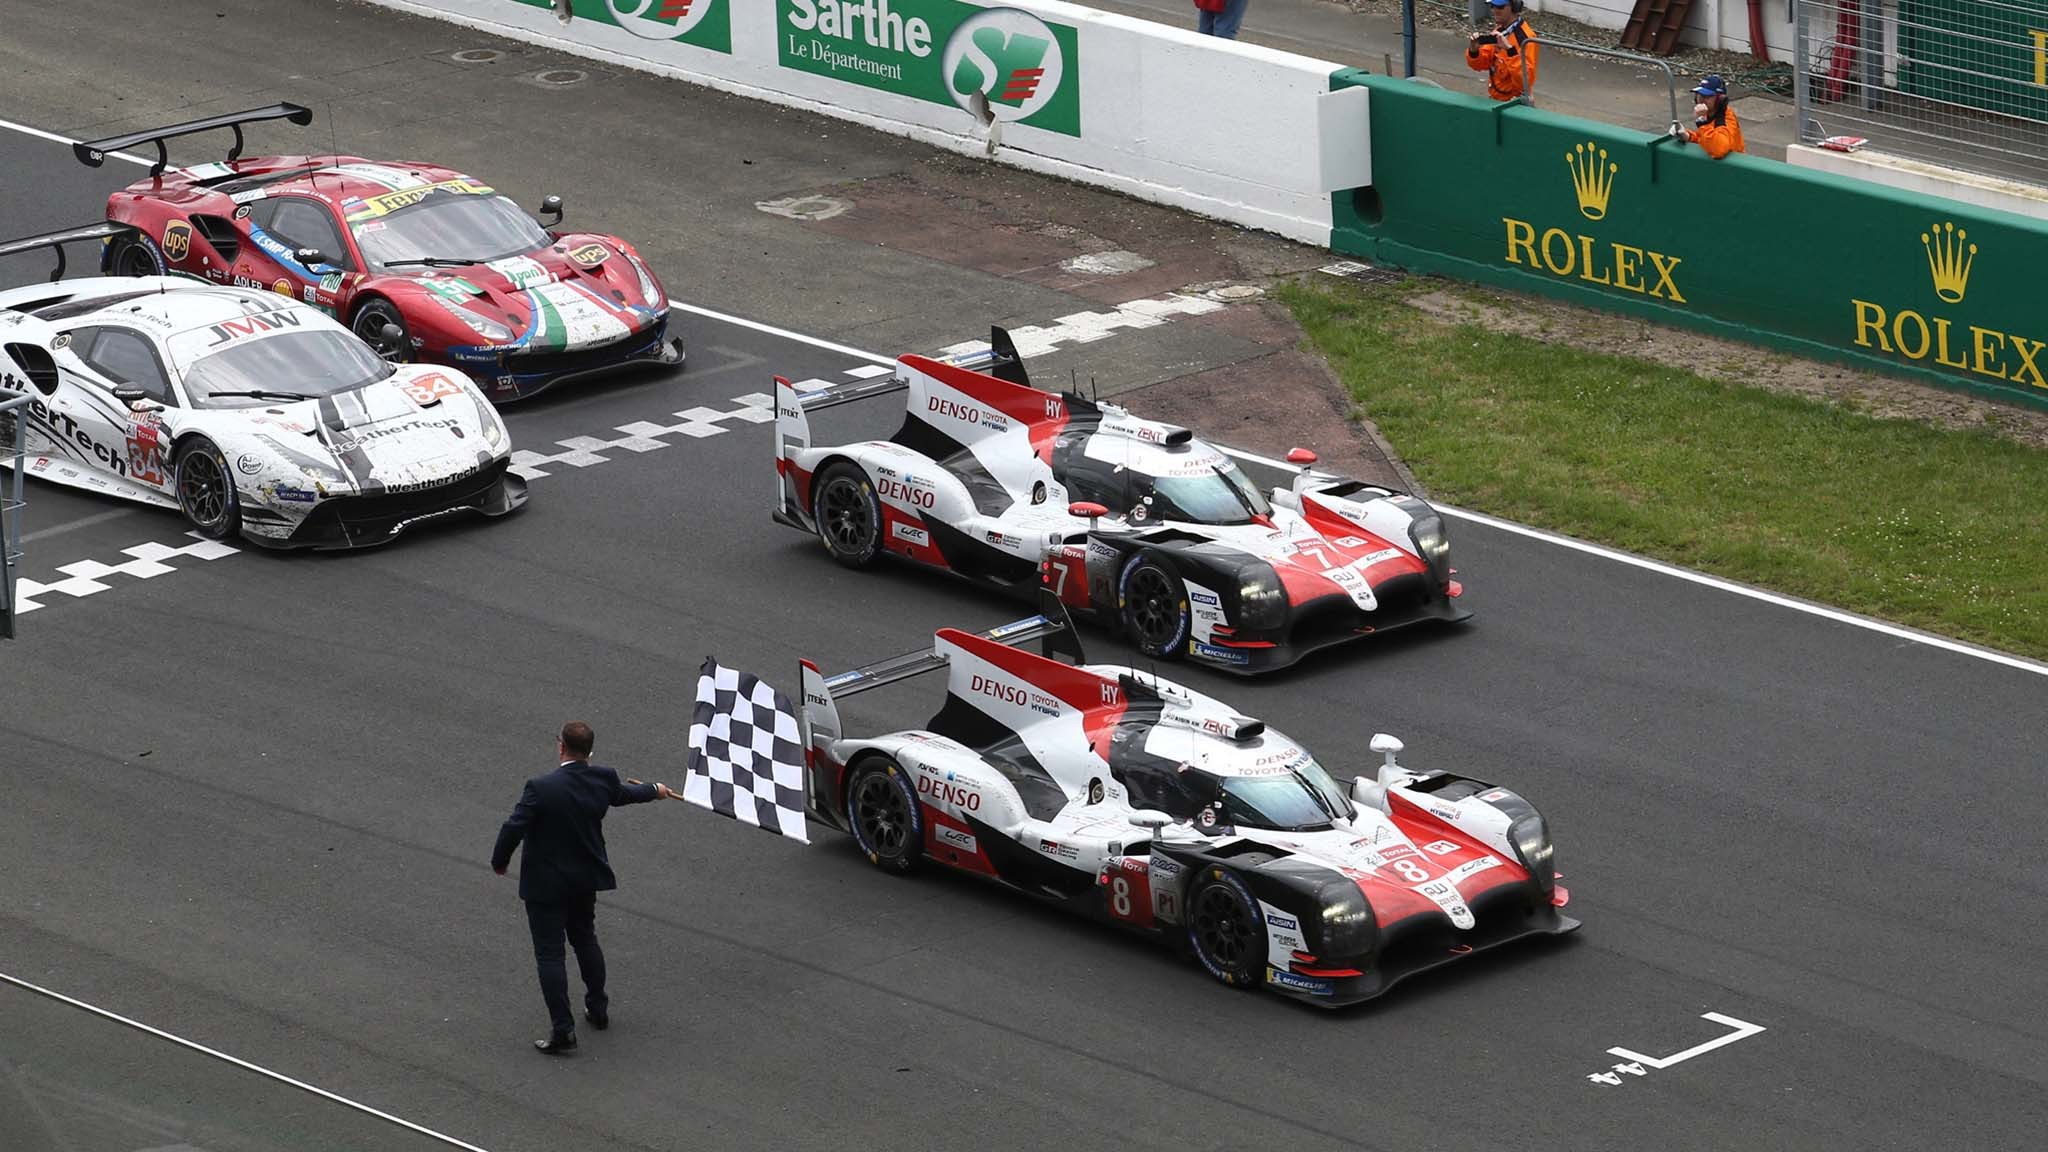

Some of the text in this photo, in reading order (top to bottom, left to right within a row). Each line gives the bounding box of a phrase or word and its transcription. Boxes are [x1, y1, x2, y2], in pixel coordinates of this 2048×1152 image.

[788, 0, 932, 57] Sarthe
[789, 34, 903, 81] Le Département
[165, 231, 188, 254] ups
[576, 247, 607, 265] ups
[1502, 217, 1687, 303] ROLEX
[233, 275, 263, 290] ADLER
[320, 273, 342, 290] PRO
[316, 293, 335, 304] TOTAL
[208, 310, 302, 348] JMW
[1851, 299, 2048, 391] ROLEX
[402, 377, 458, 405] 84
[928, 395, 979, 424] DENSO
[1045, 399, 1062, 418] HY
[981, 411, 1008, 425] TOYOTA
[981, 420, 1008, 433] HYBRID
[137, 430, 157, 443] TOTAL
[326, 417, 459, 455] WeatherTech
[1137, 426, 1162, 442] ZENT
[128, 442, 162, 478] 84
[386, 465, 478, 493] WeatherTech
[877, 478, 935, 509] DENSO
[900, 526, 924, 539] WEC
[1299, 539, 1324, 548] TOTAL
[1301, 550, 1332, 569] 7
[1053, 563, 1069, 596] 7
[1192, 594, 1217, 605] AISIN
[1204, 648, 1242, 660] MICHELIN
[970, 675, 1028, 706] DENSO
[1101, 684, 1119, 704] HY
[807, 694, 827, 706] JTEKT
[1031, 693, 1060, 709] TOYOTA
[1031, 704, 1060, 718] HYBRID
[1174, 717, 1190, 725] AISIN
[1202, 718, 1231, 736] ZENT
[1255, 748, 1298, 766] DENSO
[1238, 767, 1288, 776] TOYOTA
[917, 774, 980, 811] DENSO
[1429, 807, 1453, 820] HYBRID
[945, 831, 971, 844] WEC
[1430, 842, 1455, 851] P1
[1383, 846, 1415, 857] TOTAL
[1393, 859, 1430, 882] 8
[1461, 857, 1489, 873] WEC
[1113, 877, 1131, 916] 8
[1158, 892, 1175, 914] P1
[1268, 916, 1295, 929] AISIN
[1282, 977, 1327, 990] MICHELIN
